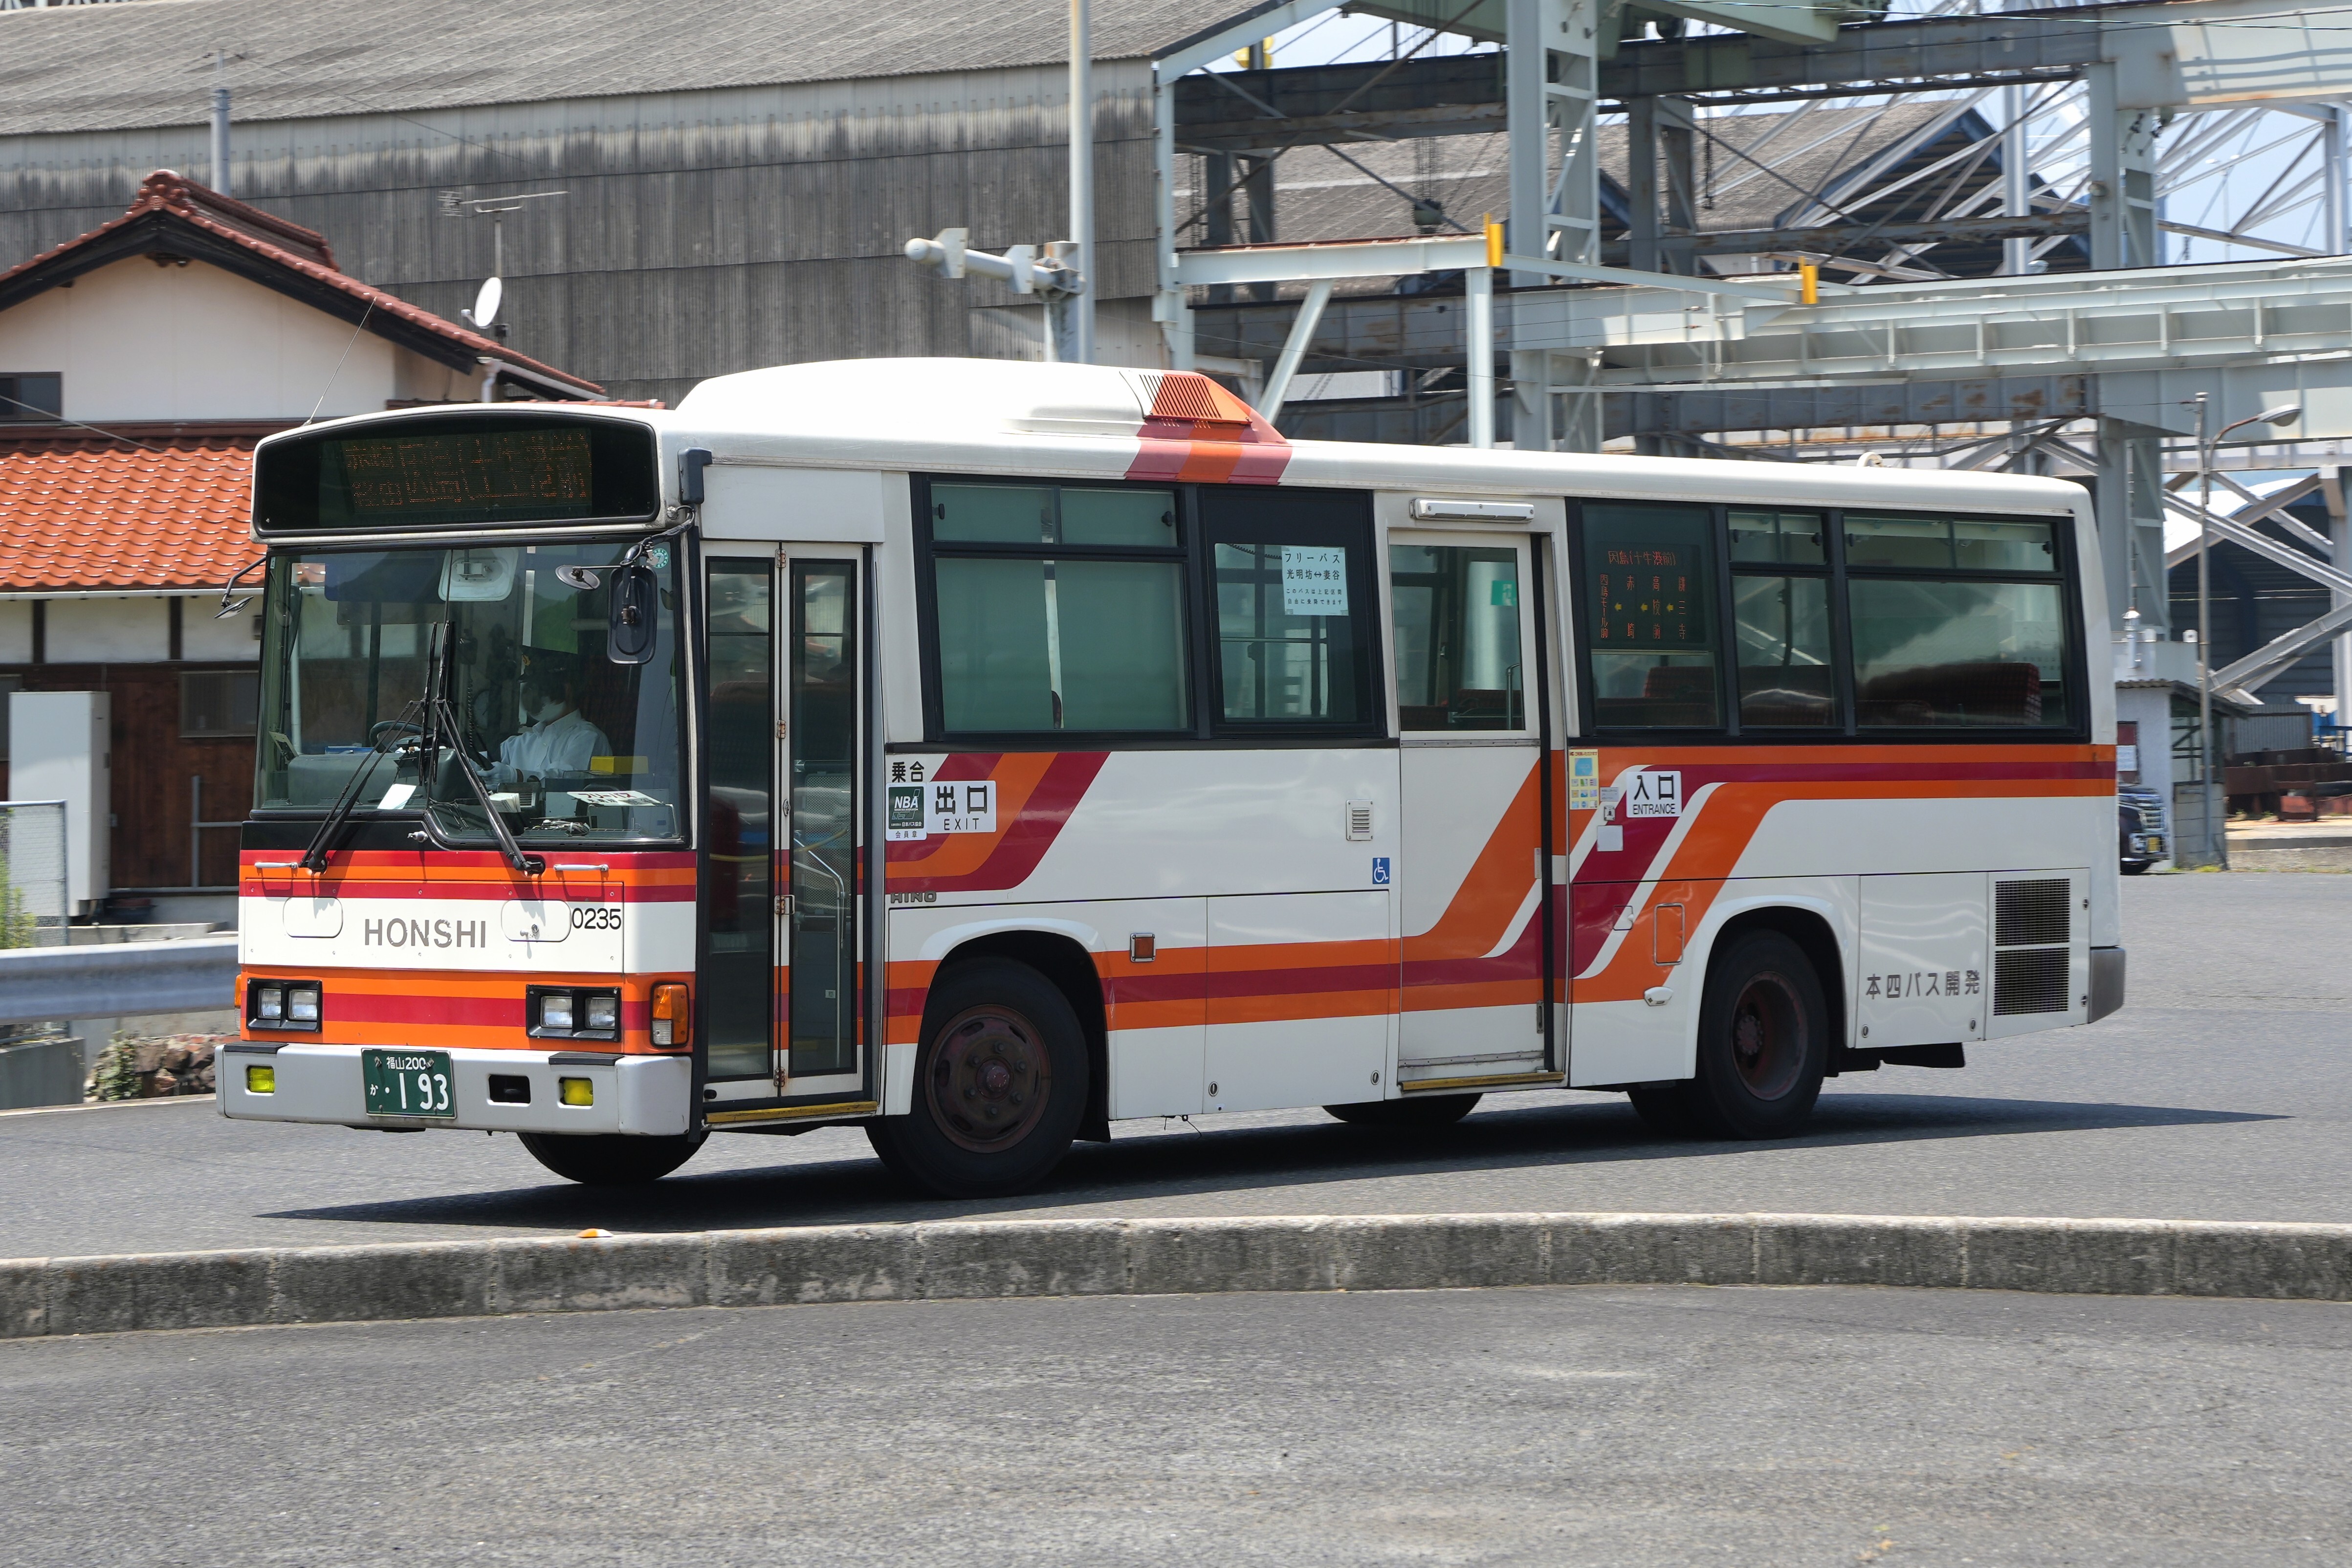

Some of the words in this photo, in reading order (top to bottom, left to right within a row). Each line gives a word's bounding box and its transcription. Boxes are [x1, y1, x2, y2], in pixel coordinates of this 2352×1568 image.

[1285, 552, 1340, 563] フリーバス
[891, 761, 924, 783] 乗合
[1634, 774, 1674, 800] 入口
[894, 796, 918, 808] NBA
[935, 785, 988, 815] 出口
[1633, 803, 1676, 815] ENTRANCE
[944, 818, 979, 830] EXIT
[890, 891, 937, 904] HINO
[571, 907, 622, 930] 0235
[364, 918, 486, 949] HONSHI
[1866, 970, 1980, 999] 本四バス開発
[370, 1083, 378, 1096] か
